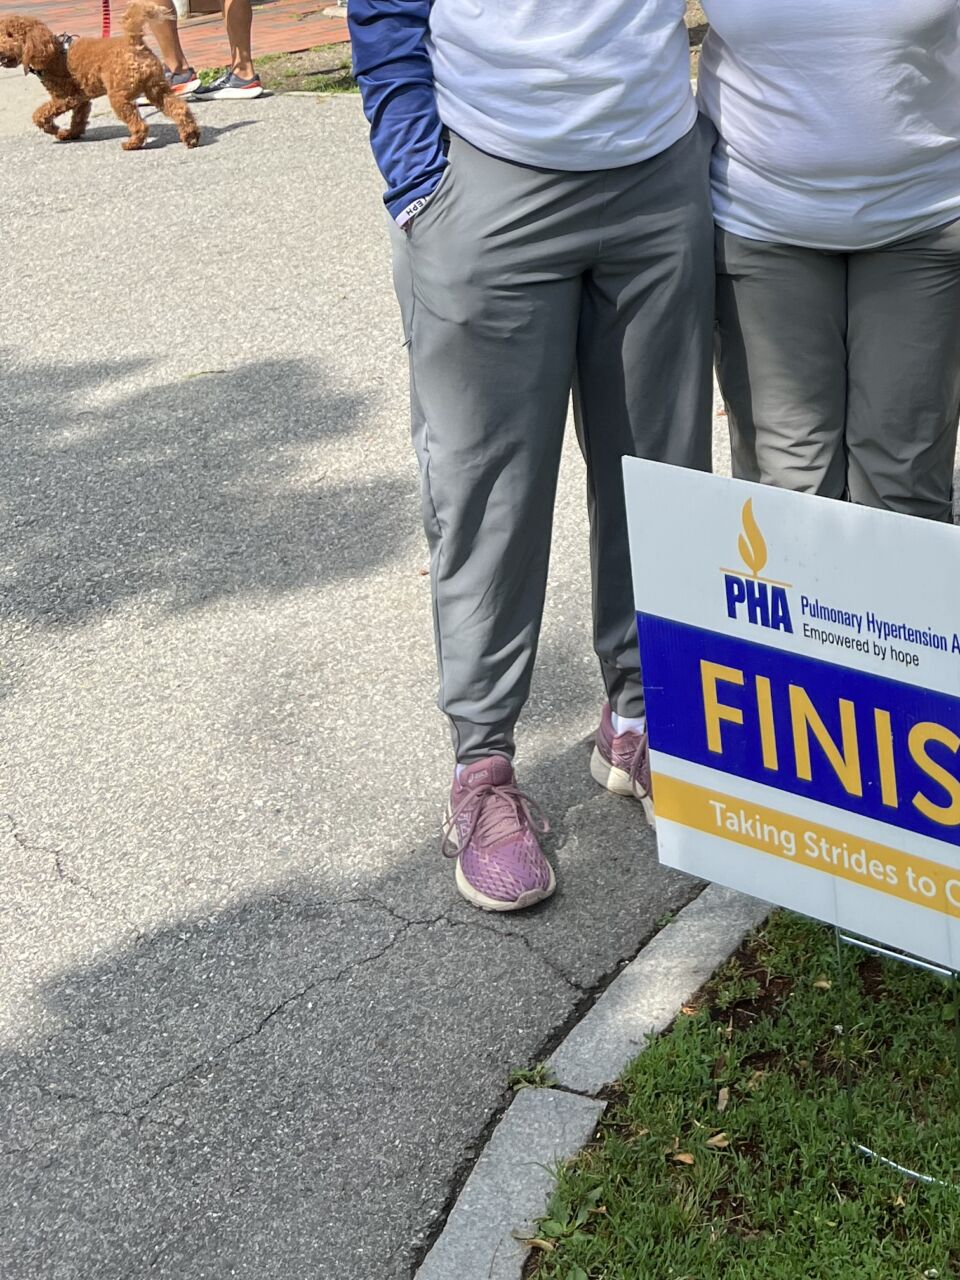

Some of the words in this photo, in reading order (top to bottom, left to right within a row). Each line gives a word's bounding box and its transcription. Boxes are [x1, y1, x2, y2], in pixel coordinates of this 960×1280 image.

[725, 574, 793, 634] PHA
[800, 595, 863, 633] Pulmonary
[866, 612, 948, 651] Hypertension
[803, 623, 869, 653] Empowered
[873, 642, 886, 660] by
[890, 646, 920, 667] hope
[709, 800, 797, 856] Taking
[803, 831, 898, 885] Strides
[906, 867, 937, 898] to
